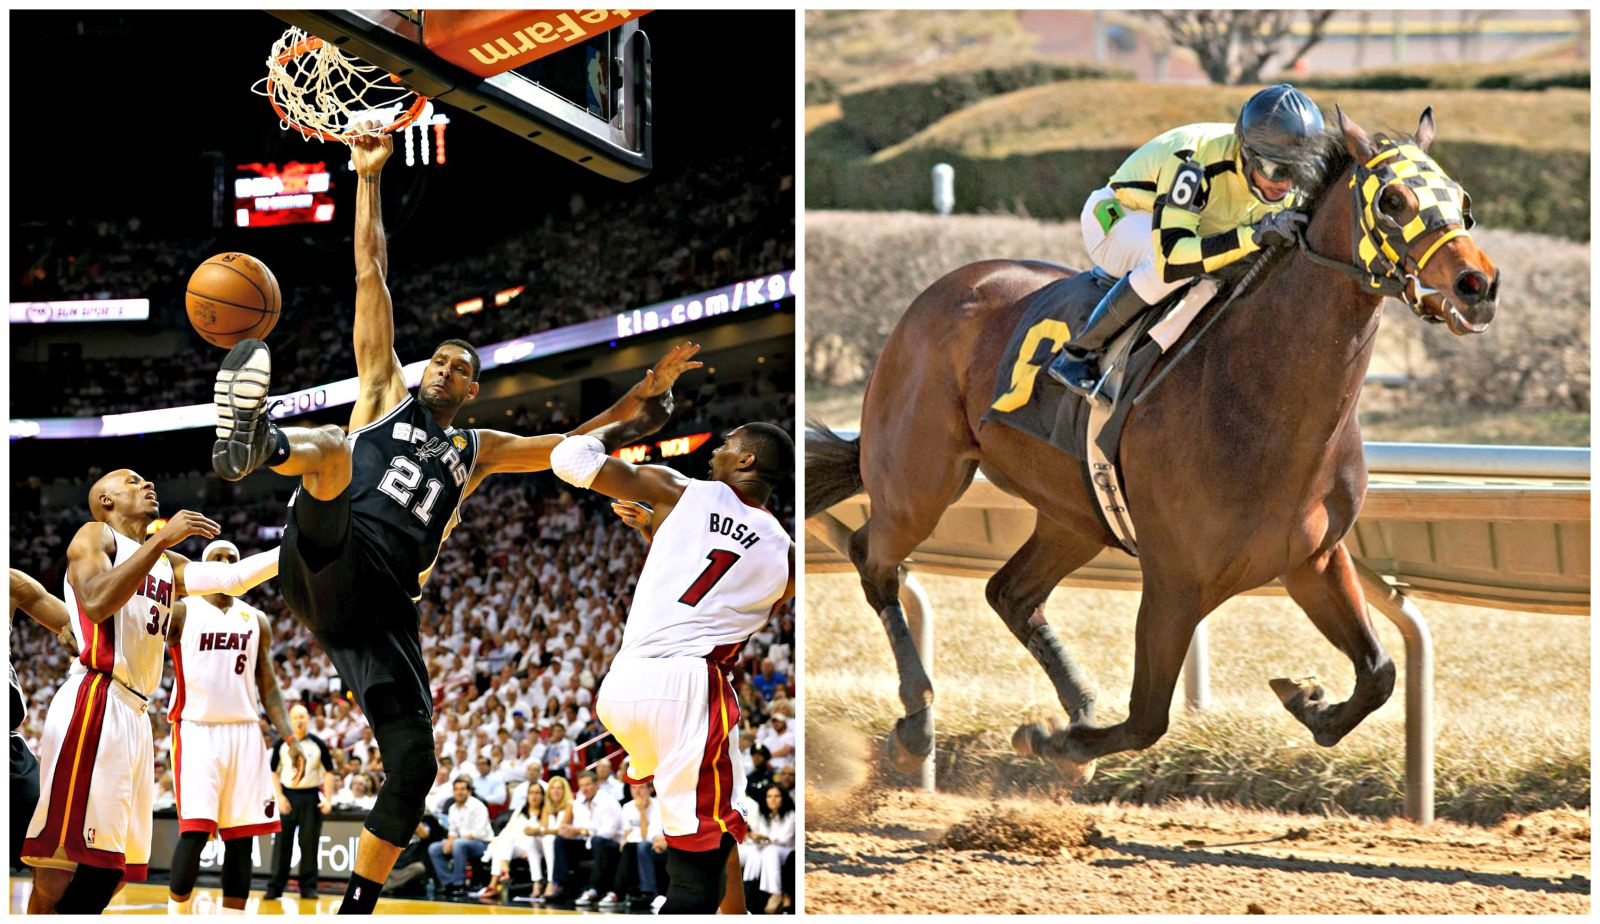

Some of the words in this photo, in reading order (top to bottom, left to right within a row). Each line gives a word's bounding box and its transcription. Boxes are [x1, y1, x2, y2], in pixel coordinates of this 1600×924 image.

[1171, 170, 1198, 205] 6
[377, 455, 444, 526] 21
[709, 512, 761, 550] BOSH
[677, 548, 742, 607] 1
[199, 629, 253, 651] HEAT
[234, 653, 247, 675] 6
